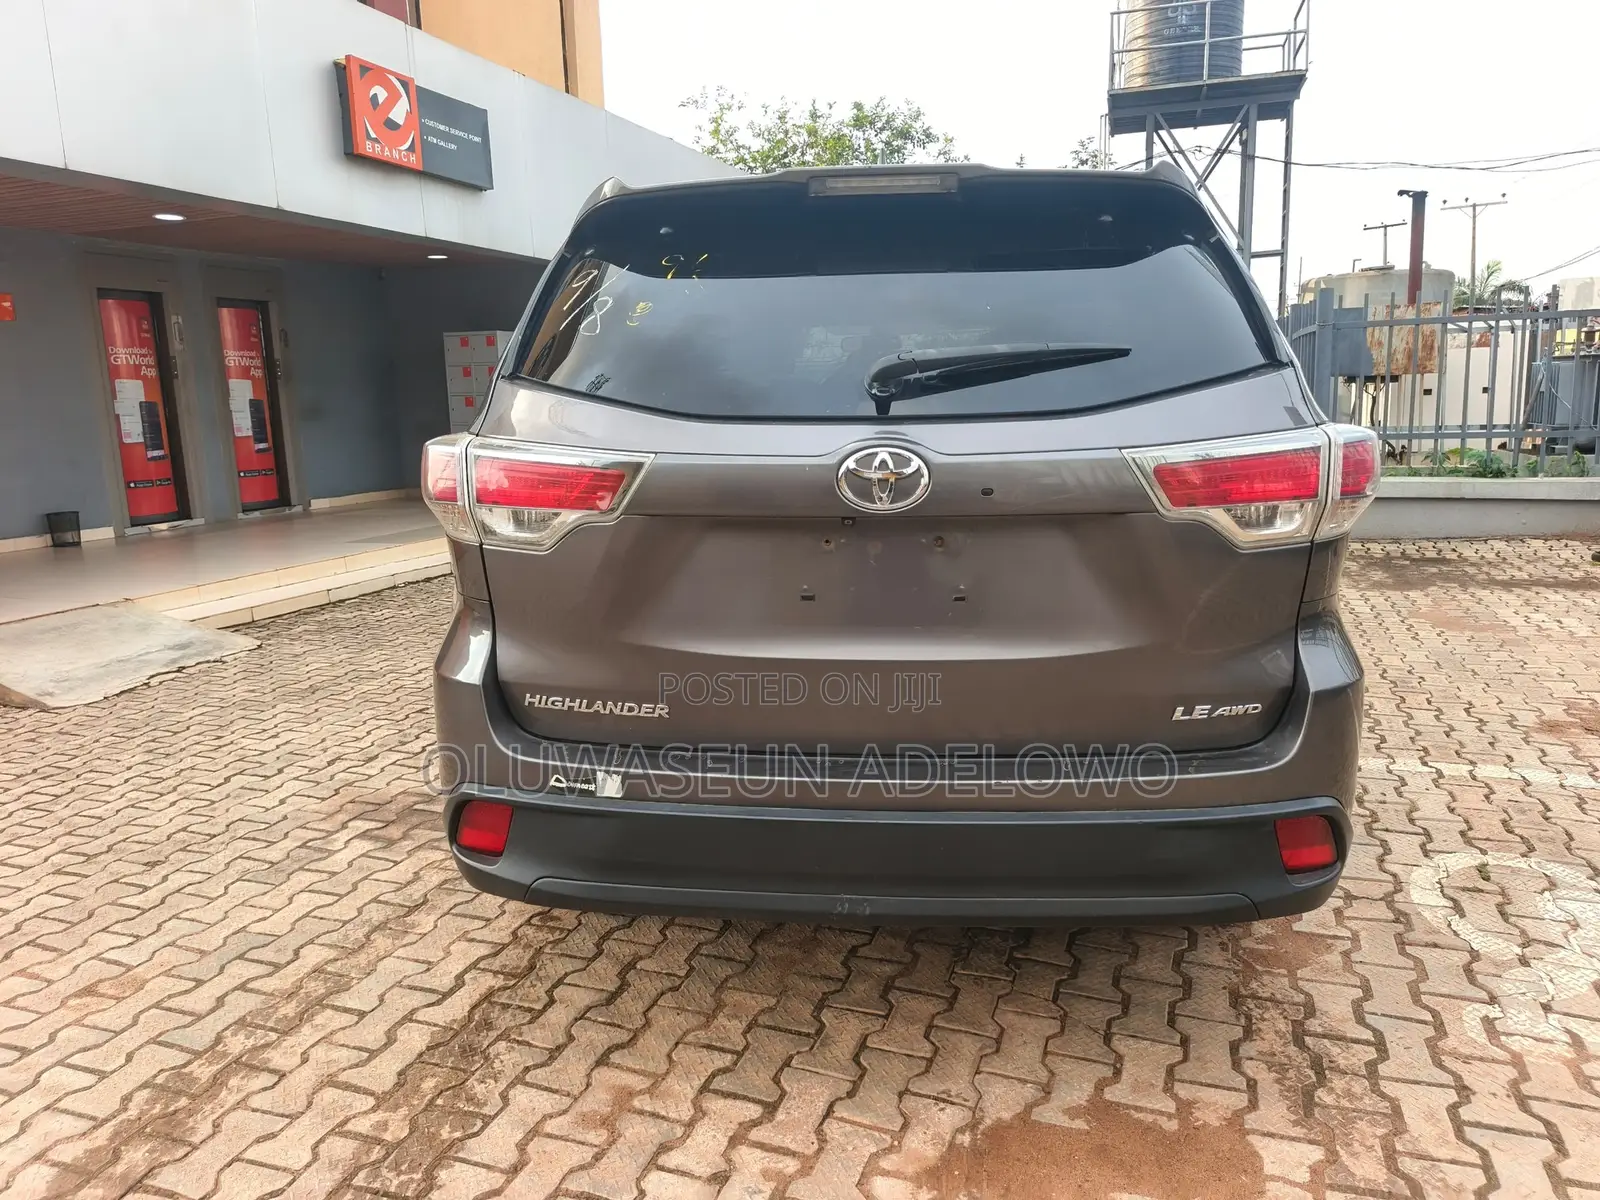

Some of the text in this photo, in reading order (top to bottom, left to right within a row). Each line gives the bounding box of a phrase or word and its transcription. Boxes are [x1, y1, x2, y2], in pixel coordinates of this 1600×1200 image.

[425, 118, 482, 143] CUSTOMER SERVICE POINT
[428, 136, 458, 150] ATM GALLERY
[365, 141, 416, 164] BRANCH
[108, 346, 148, 355] Download
[223, 349, 256, 357] Download
[110, 354, 155, 365] GTWorld
[224, 356, 261, 367] GTWorld
[140, 365, 157, 379] App
[250, 367, 264, 379] App
[524, 693, 670, 719] HIGHLANDER
[1171, 702, 1263, 722] LE AWD
